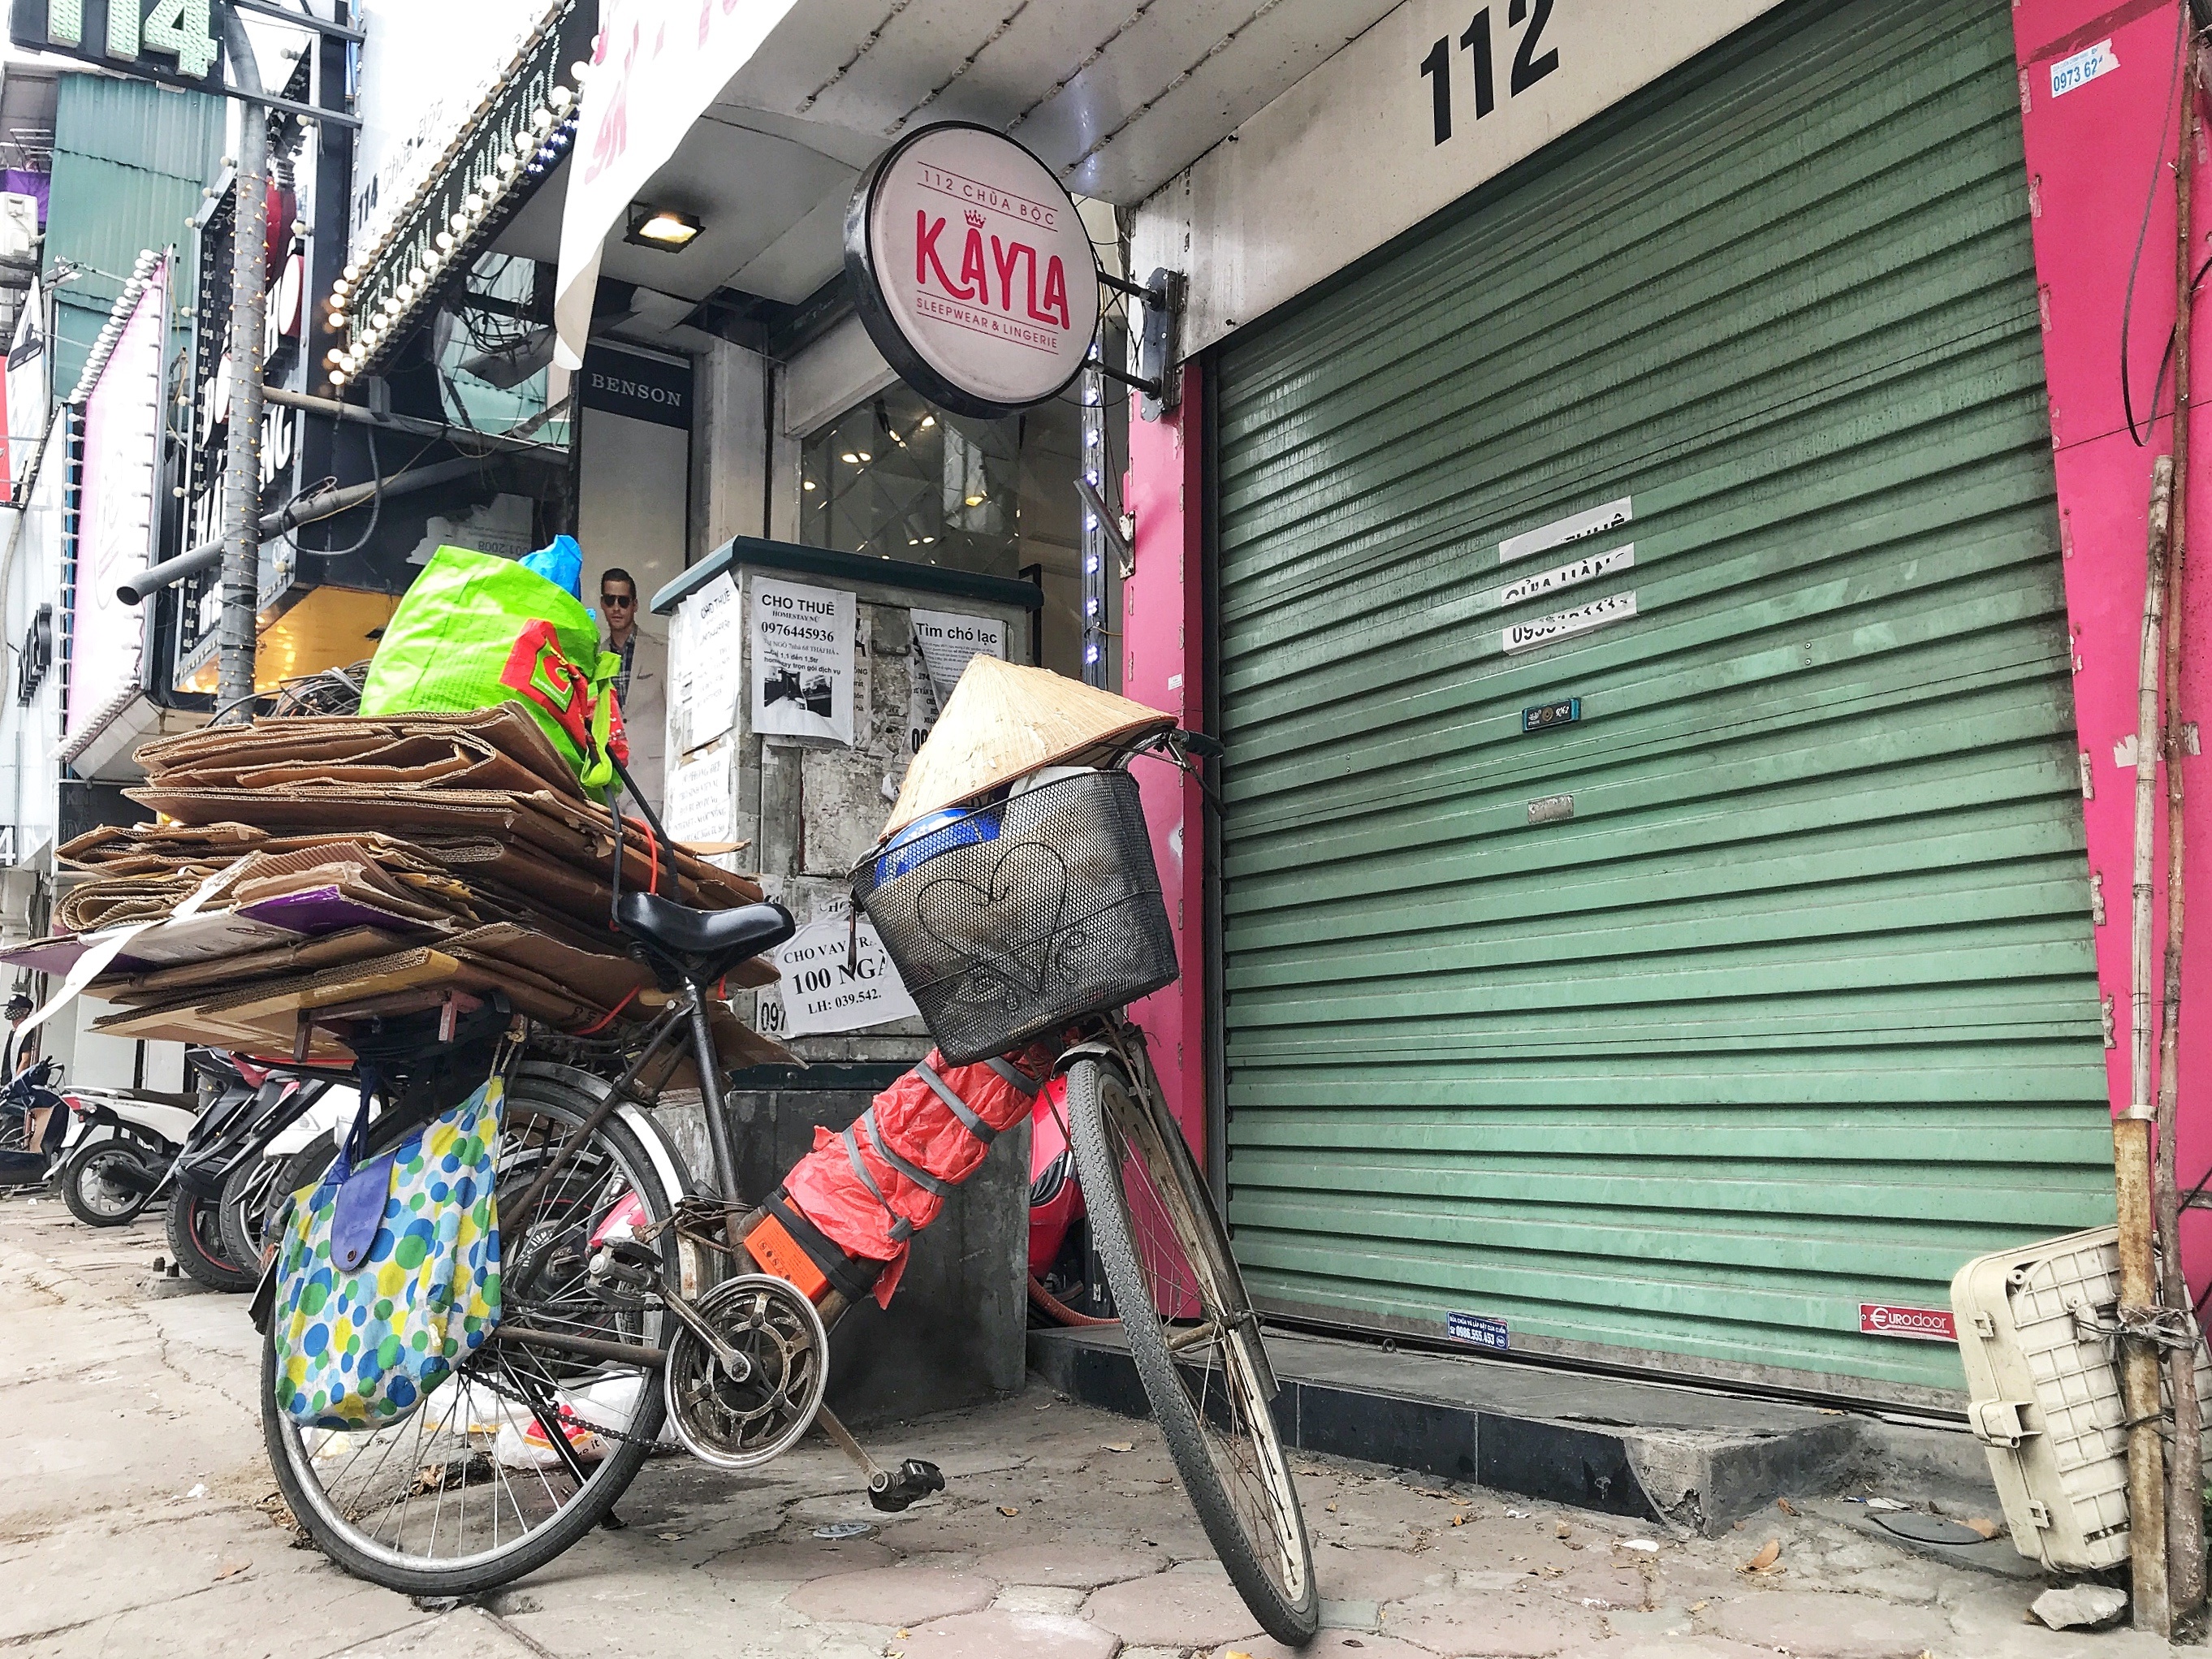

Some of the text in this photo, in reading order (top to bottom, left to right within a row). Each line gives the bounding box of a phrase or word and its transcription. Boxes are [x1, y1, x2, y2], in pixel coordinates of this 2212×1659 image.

[1420, 0, 1560, 148] 112
[2054, 66, 2080, 92] 0973
[924, 170, 1055, 225] 112 CHÙA BỘC
[916, 209, 1071, 331] KAYLA
[916, 297, 1058, 349] SLEEPWEAR & LINGERIE
[591, 373, 682, 407] BENSON
[762, 594, 835, 616] CHO THUÊ
[772, 610, 809, 622] HOMESTAY
[761, 621, 835, 643] 0976445936
[916, 622, 998, 646] Tìm chó lạc
[784, 947, 815, 965] CHO
[818, 940, 847, 957] VAY
[792, 966, 832, 996] 100
[807, 999, 833, 1014] LH:
[590, 1439, 600, 1450] it
